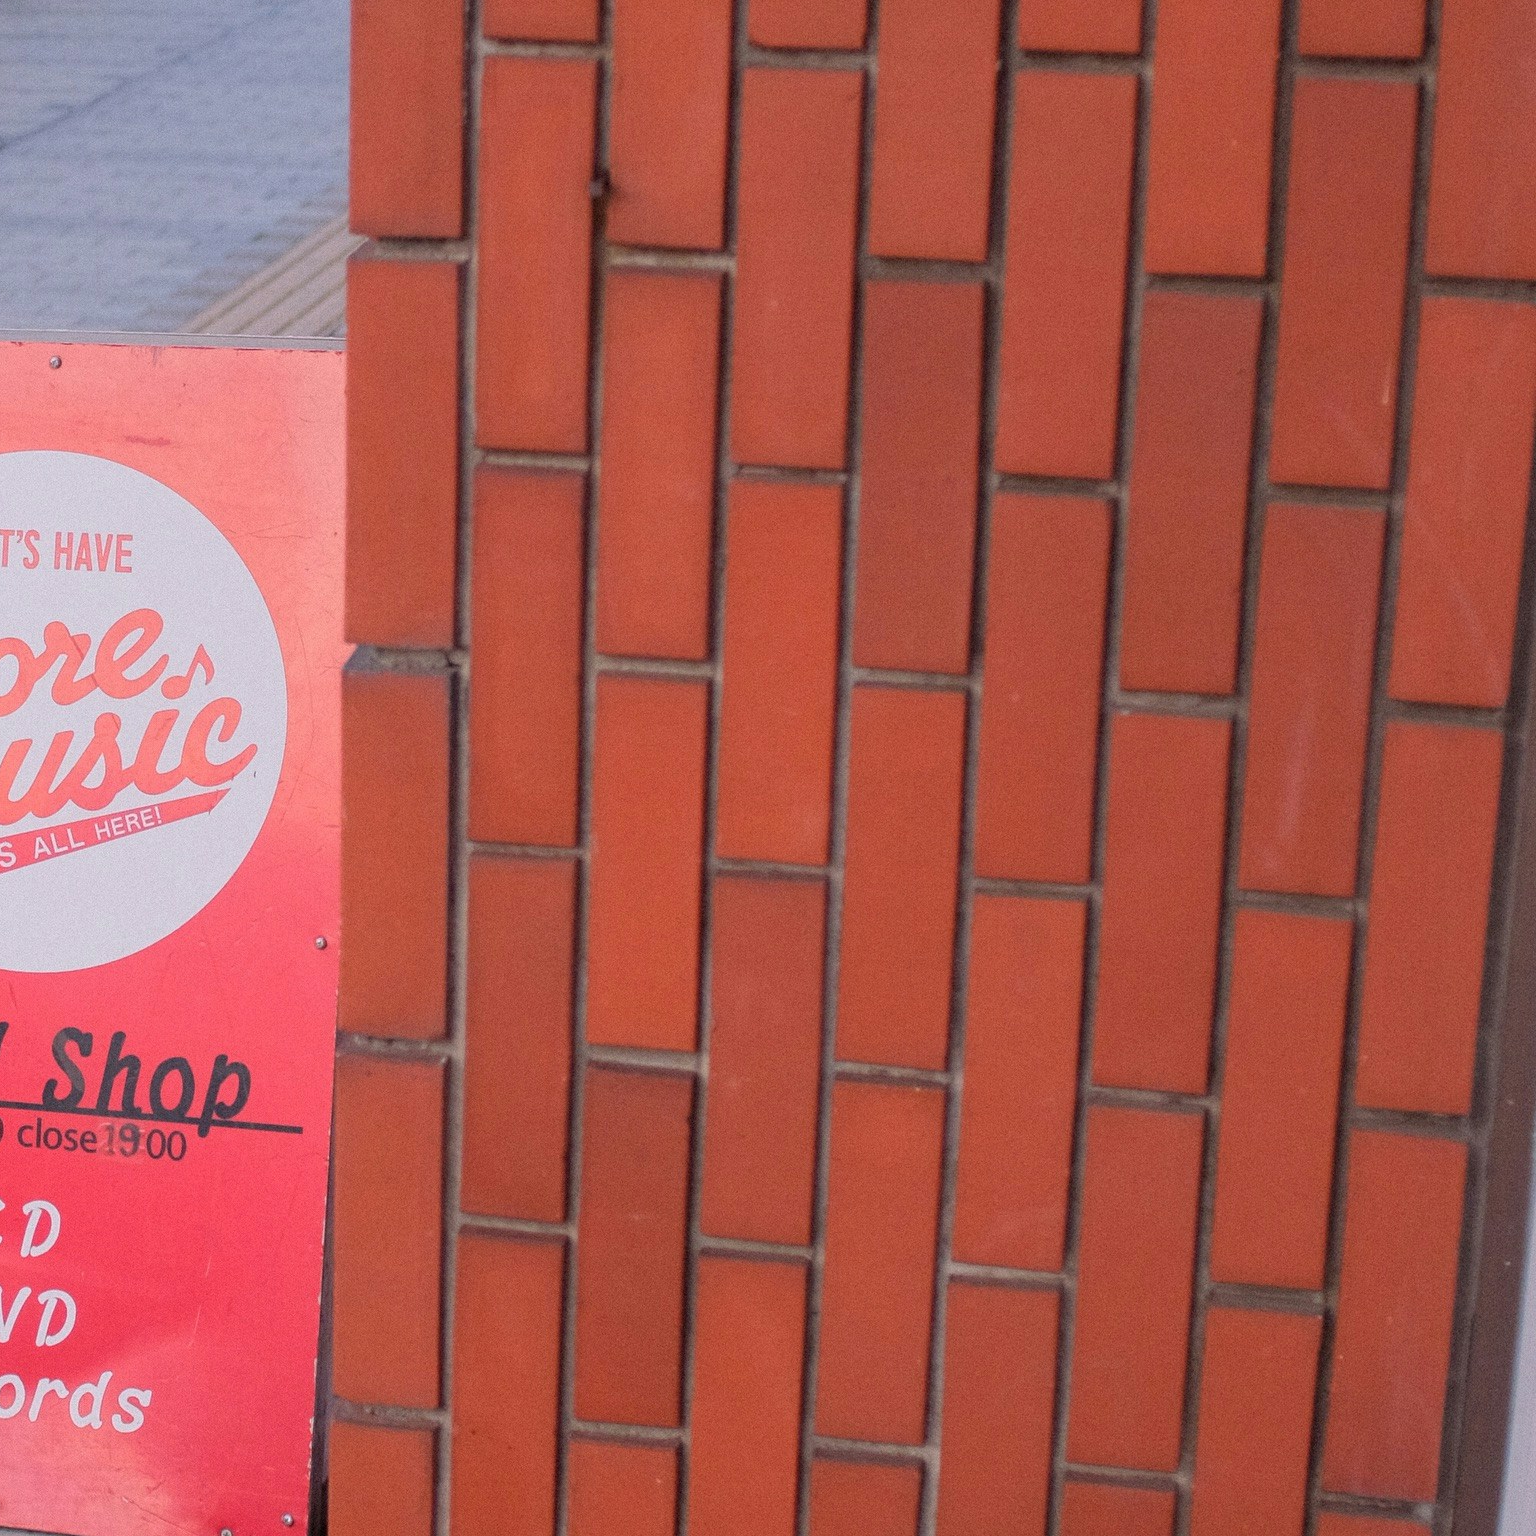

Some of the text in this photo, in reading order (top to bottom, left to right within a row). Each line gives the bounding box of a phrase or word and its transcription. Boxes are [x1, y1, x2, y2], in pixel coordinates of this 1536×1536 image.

[53, 531, 134, 574] HAVE
[32, 828, 86, 860] ALL
[94, 806, 163, 840] HERE!
[42, 1026, 252, 1138] Shop
